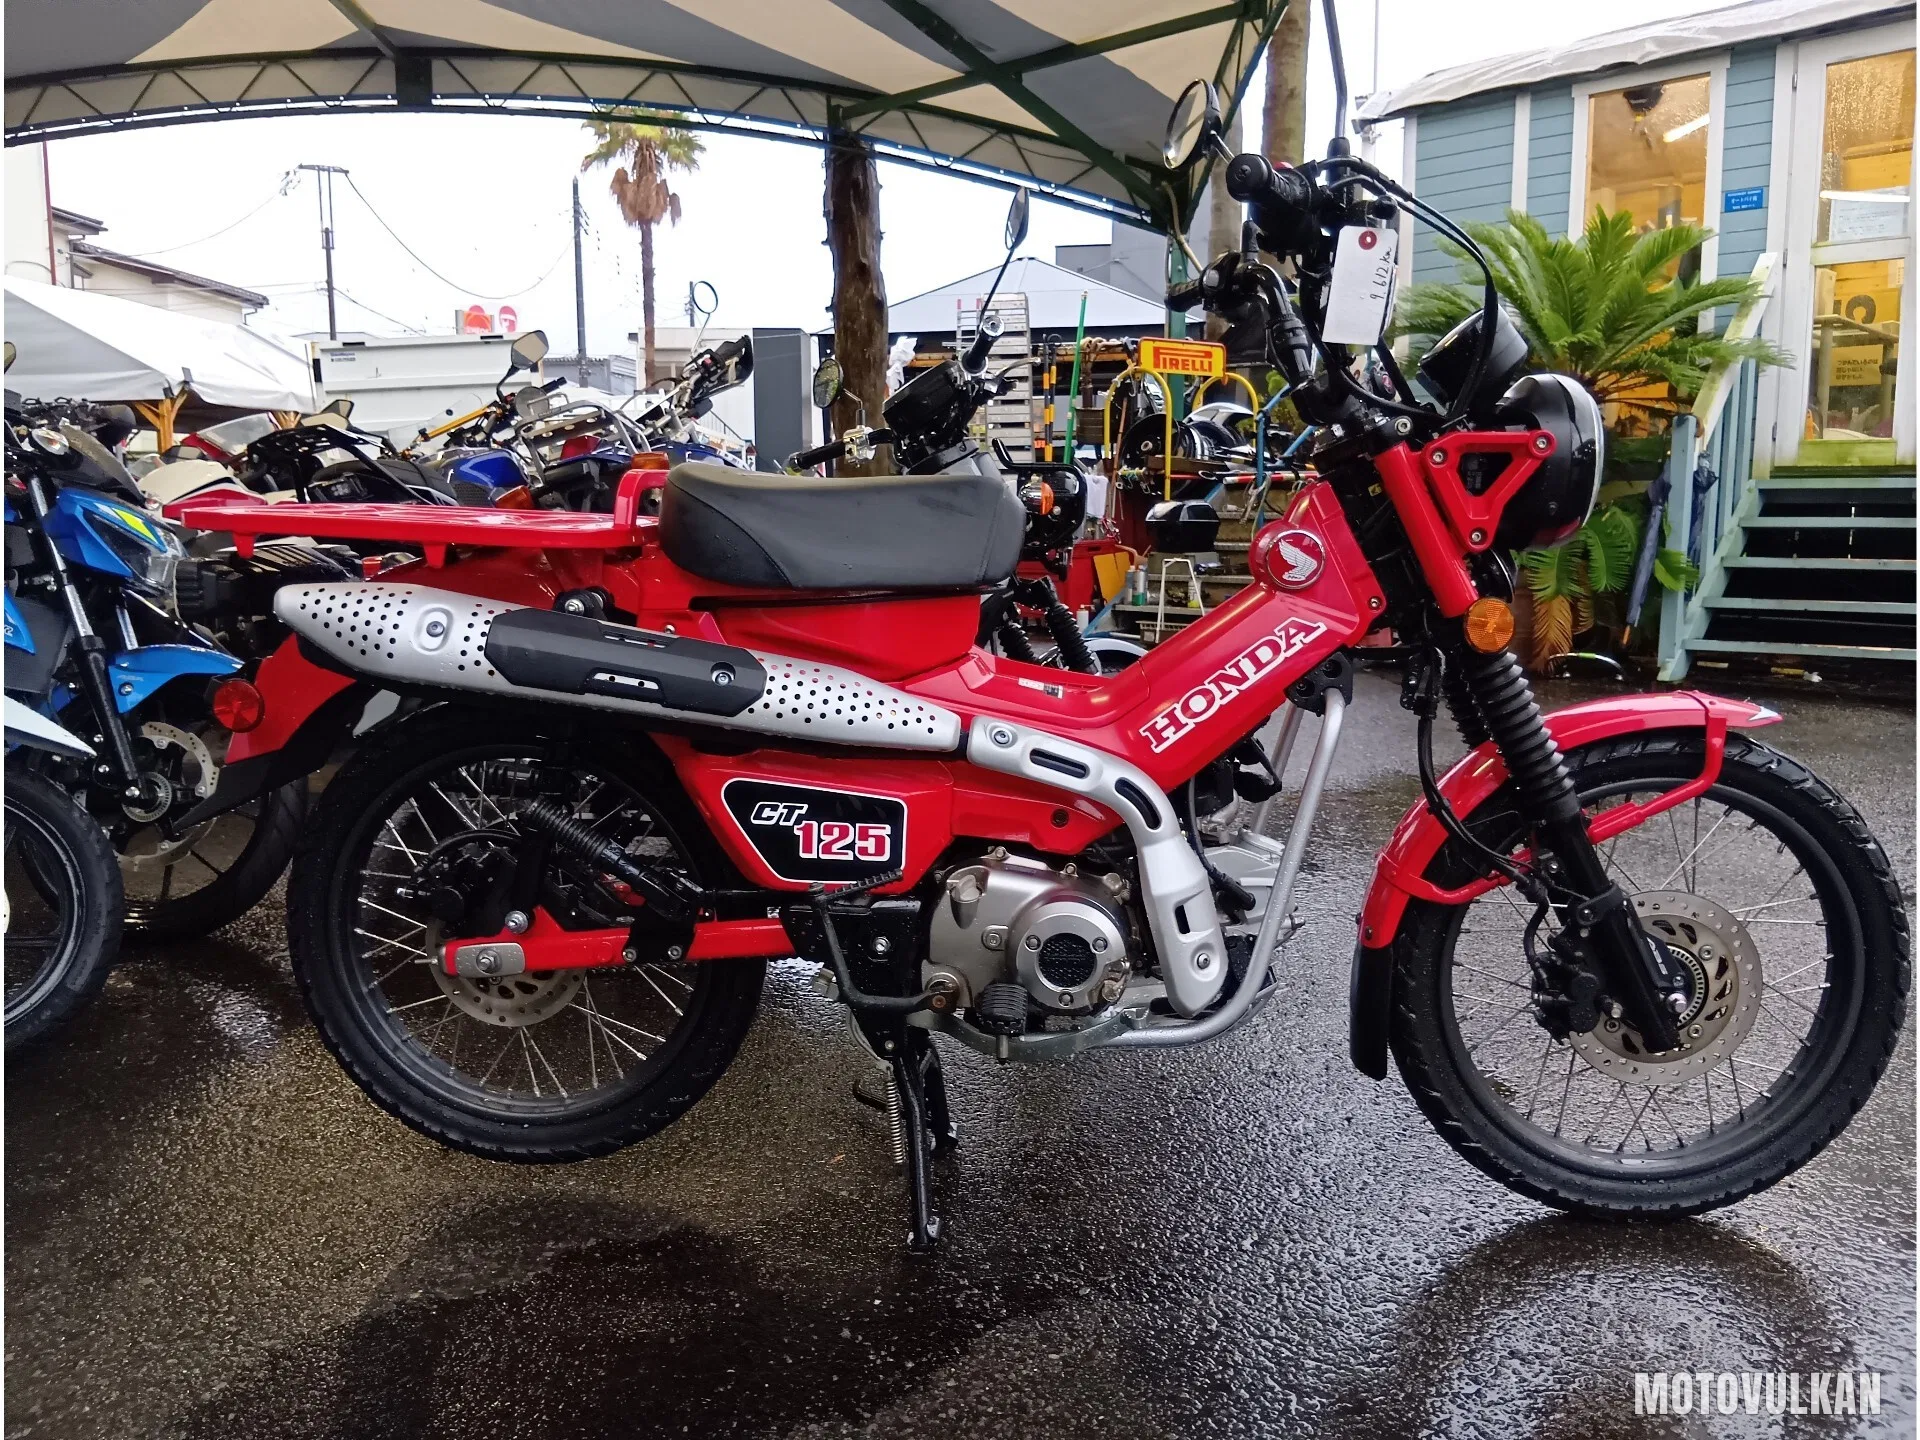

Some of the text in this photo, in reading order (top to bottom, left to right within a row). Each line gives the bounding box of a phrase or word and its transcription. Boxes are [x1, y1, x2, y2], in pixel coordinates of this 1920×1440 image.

[1153, 346, 1213, 373] PIRELLI
[1139, 617, 1327, 753] HONDA
[751, 802, 808, 826] CT
[794, 820, 891, 861] 125
